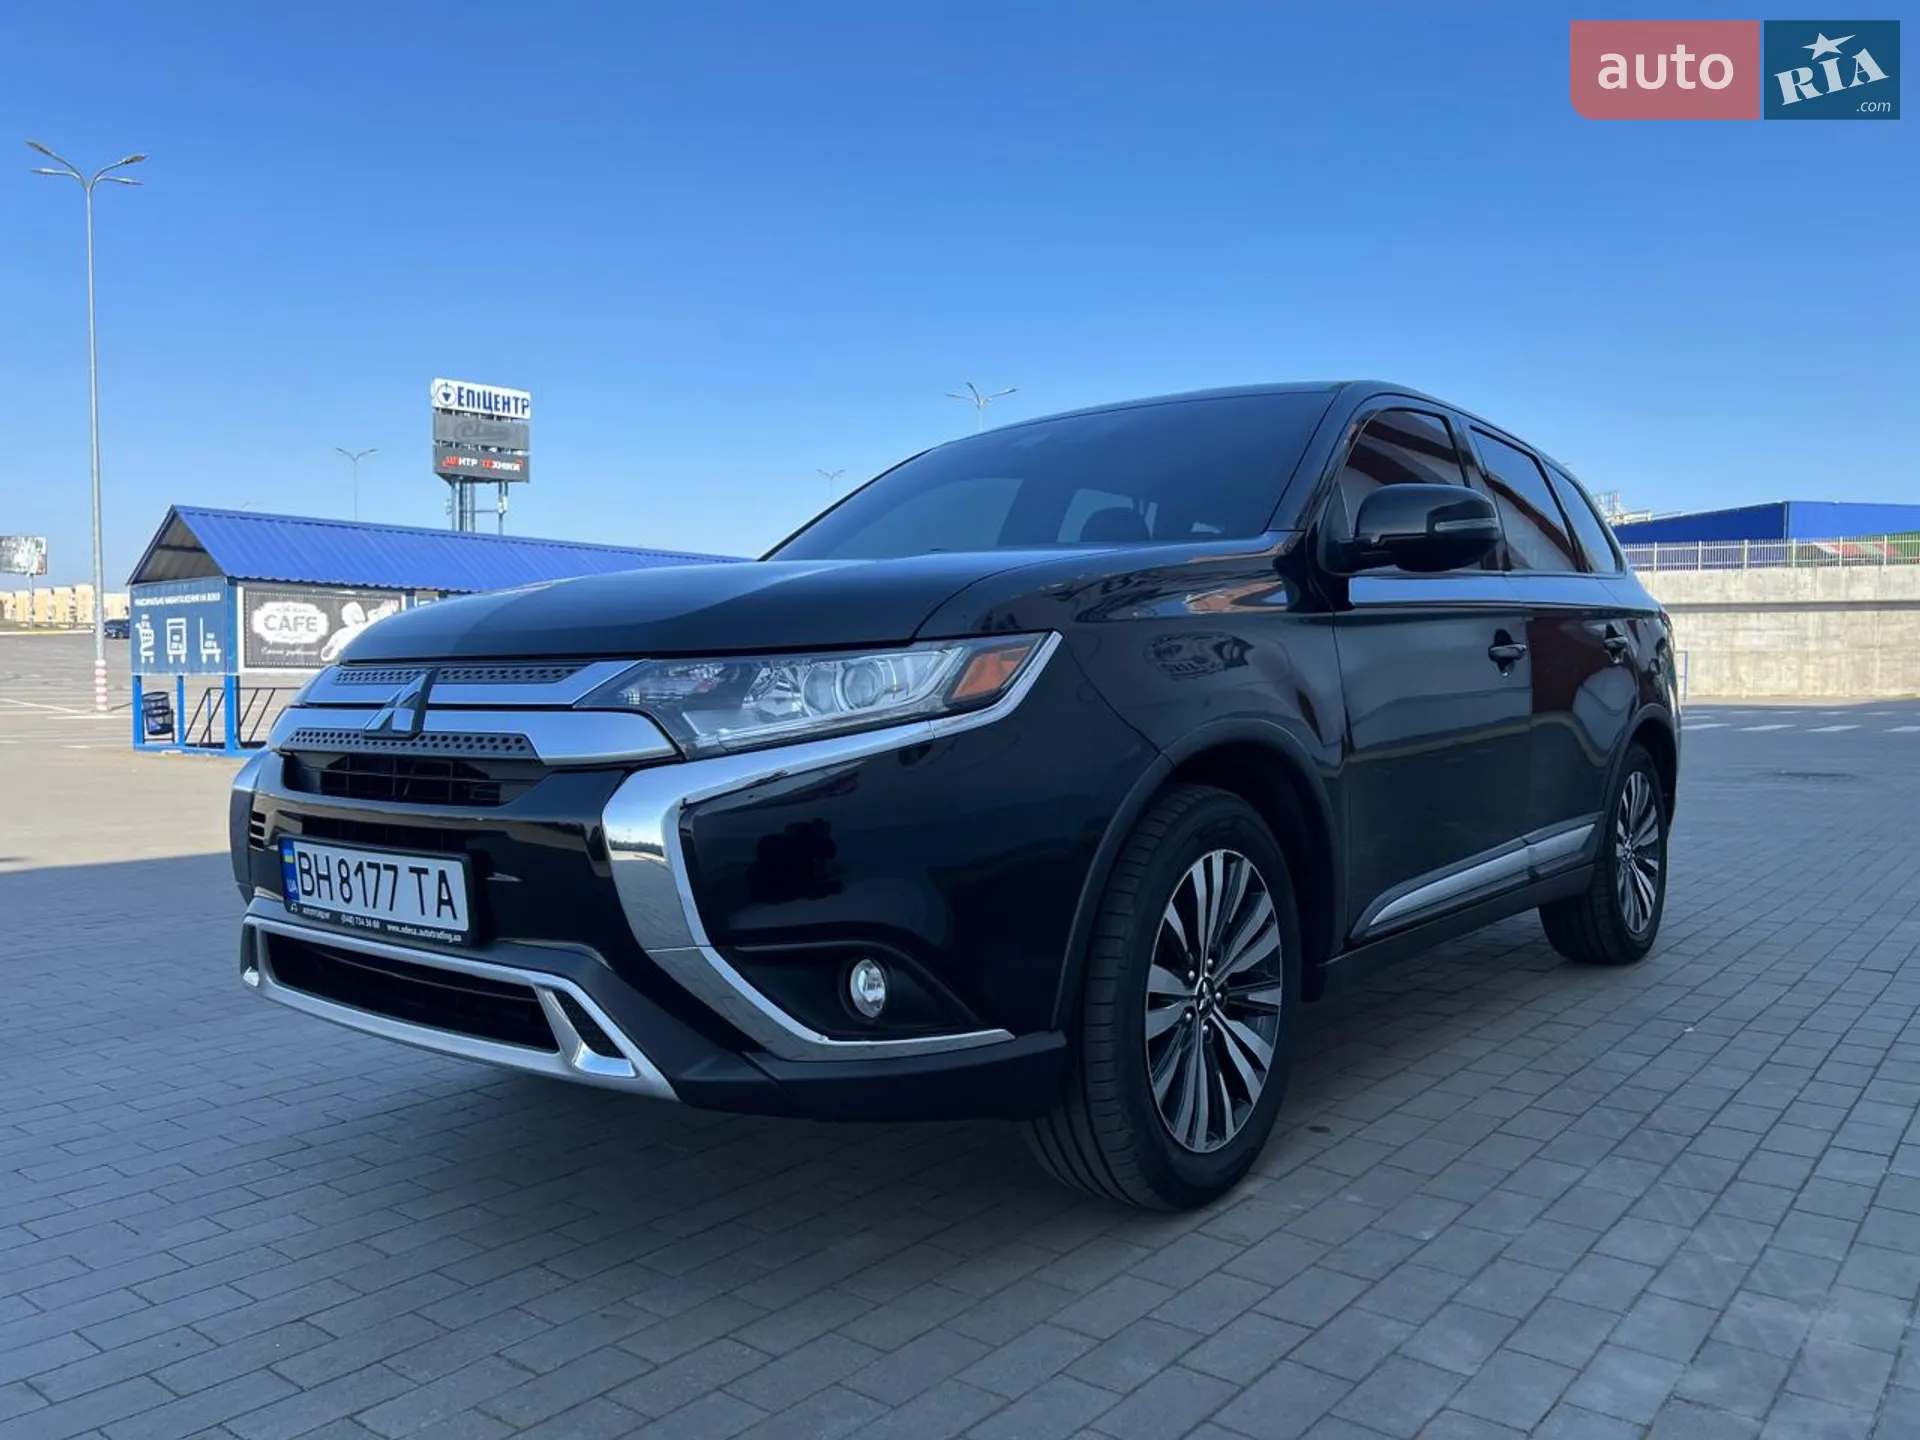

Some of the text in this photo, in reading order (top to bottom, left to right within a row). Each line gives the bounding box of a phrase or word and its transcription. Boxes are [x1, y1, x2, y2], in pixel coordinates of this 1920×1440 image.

[457, 385, 530, 415] ЕПІЦЕНТР
[264, 614, 318, 632] CAFE
[409, 866, 458, 920] TA
